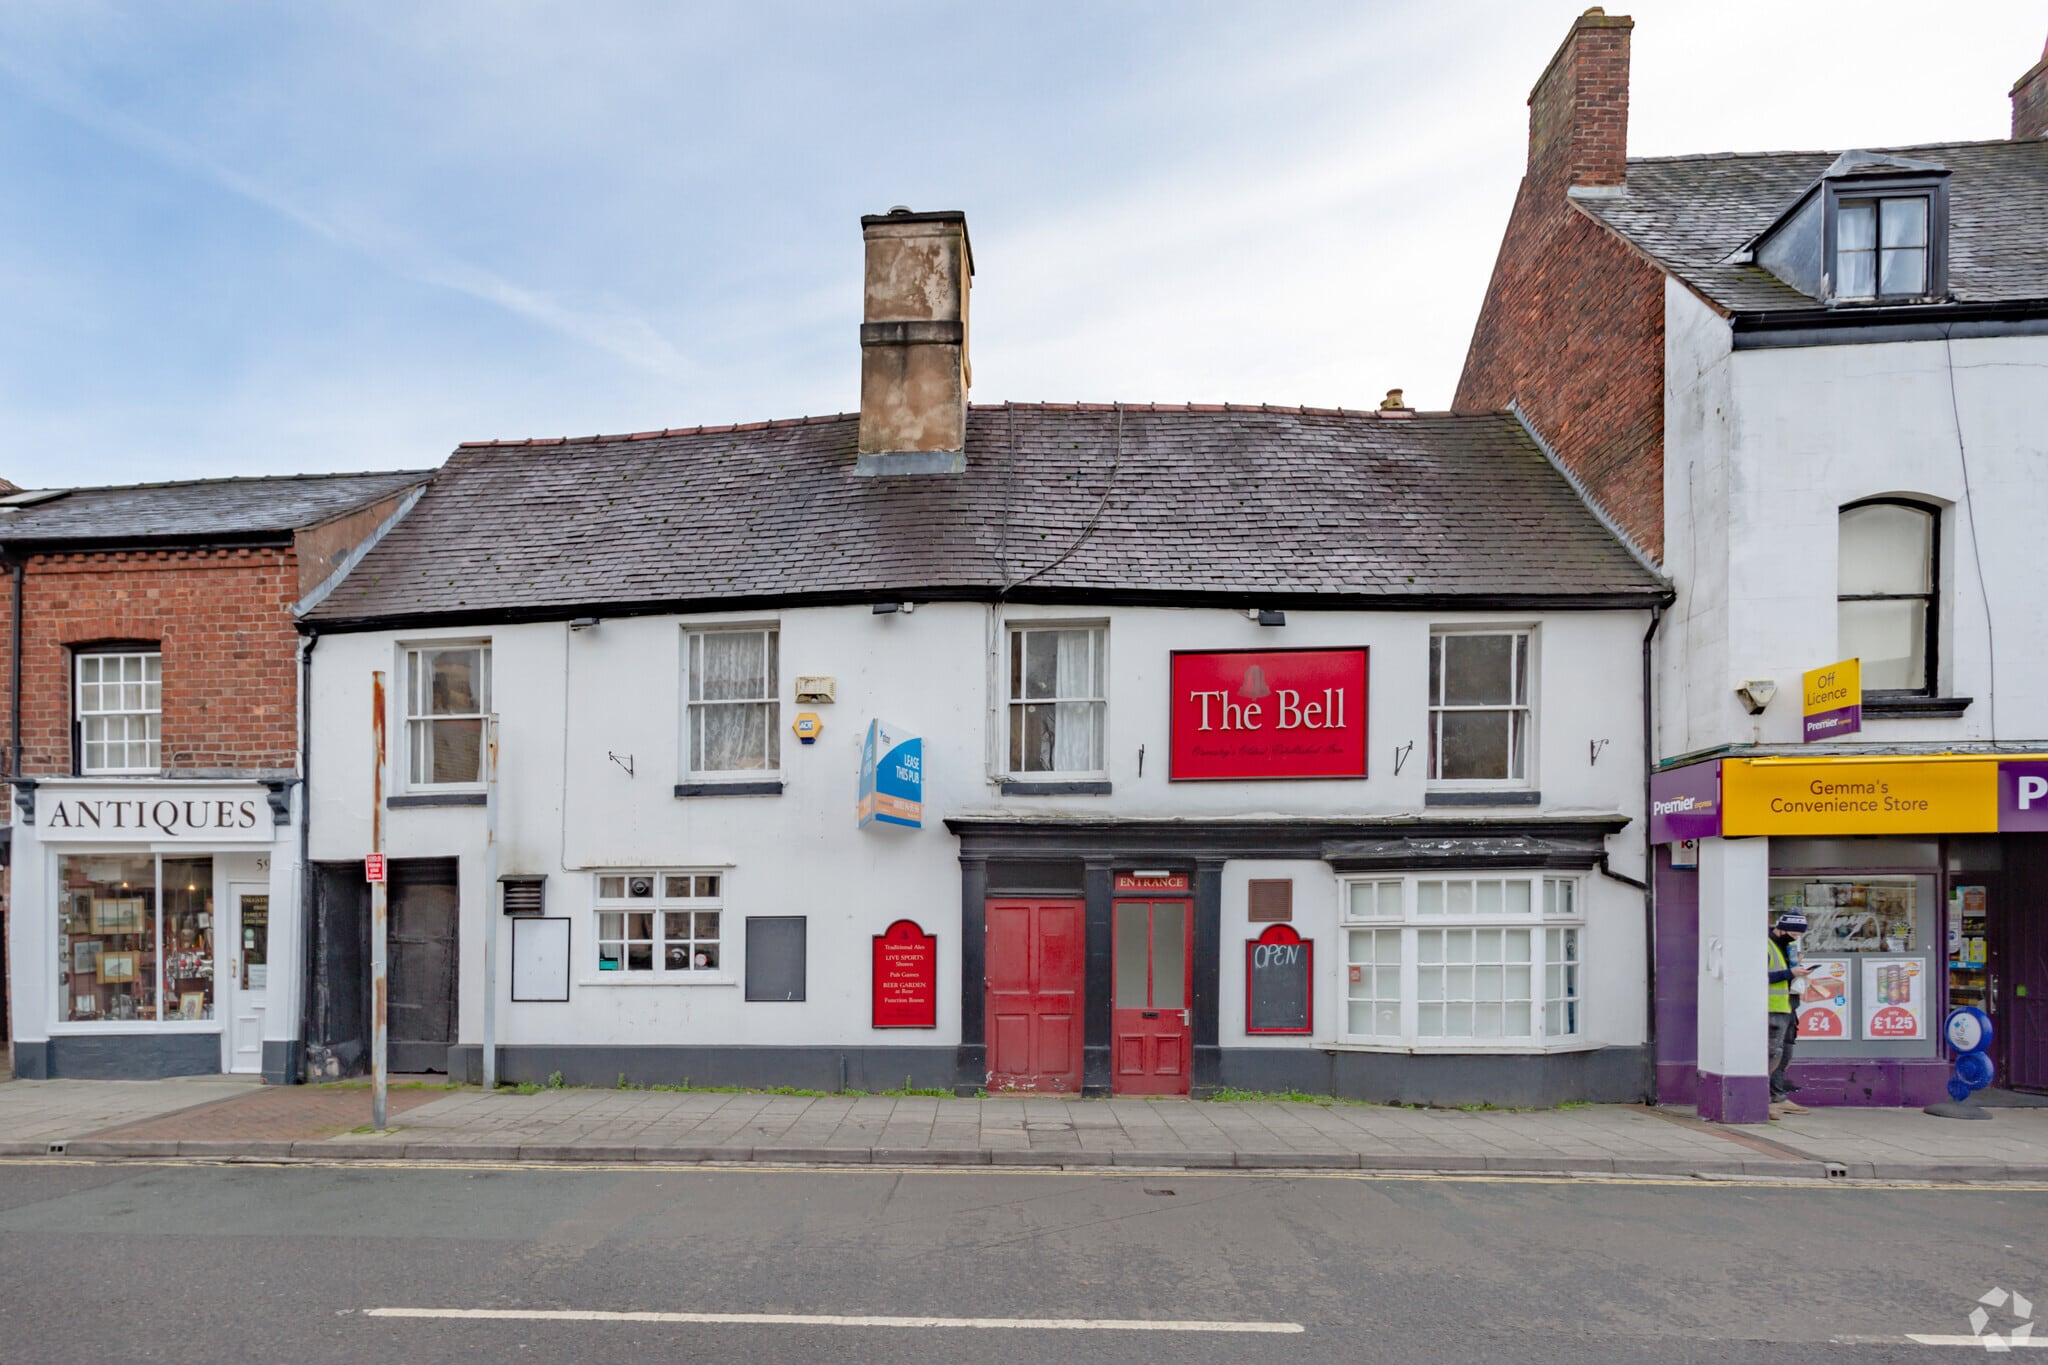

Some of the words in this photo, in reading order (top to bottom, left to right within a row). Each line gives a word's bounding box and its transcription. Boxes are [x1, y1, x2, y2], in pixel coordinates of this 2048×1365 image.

[1818, 672, 1835, 689] Off
[1807, 688, 1848, 706] Licence
[1190, 690, 1263, 731] The
[1275, 687, 1347, 730] Bell
[1807, 718, 1839, 732] Premier
[904, 753, 919, 770] LEASE
[896, 766, 908, 781] THIS
[909, 770, 920, 784] PUB
[1810, 779, 1889, 796] Gemma's
[2018, 776, 2048, 810] P
[1653, 796, 1695, 816] Premier
[1770, 797, 1879, 814] Convenience
[1884, 797, 1929, 813] Store
[48, 800, 257, 836] ANTIQUES
[1119, 877, 1184, 888] ENTRANCE
[1254, 944, 1300, 968] OPEN
[1808, 1017, 1831, 1031] £4
[1874, 1016, 1914, 1031] £1.25
